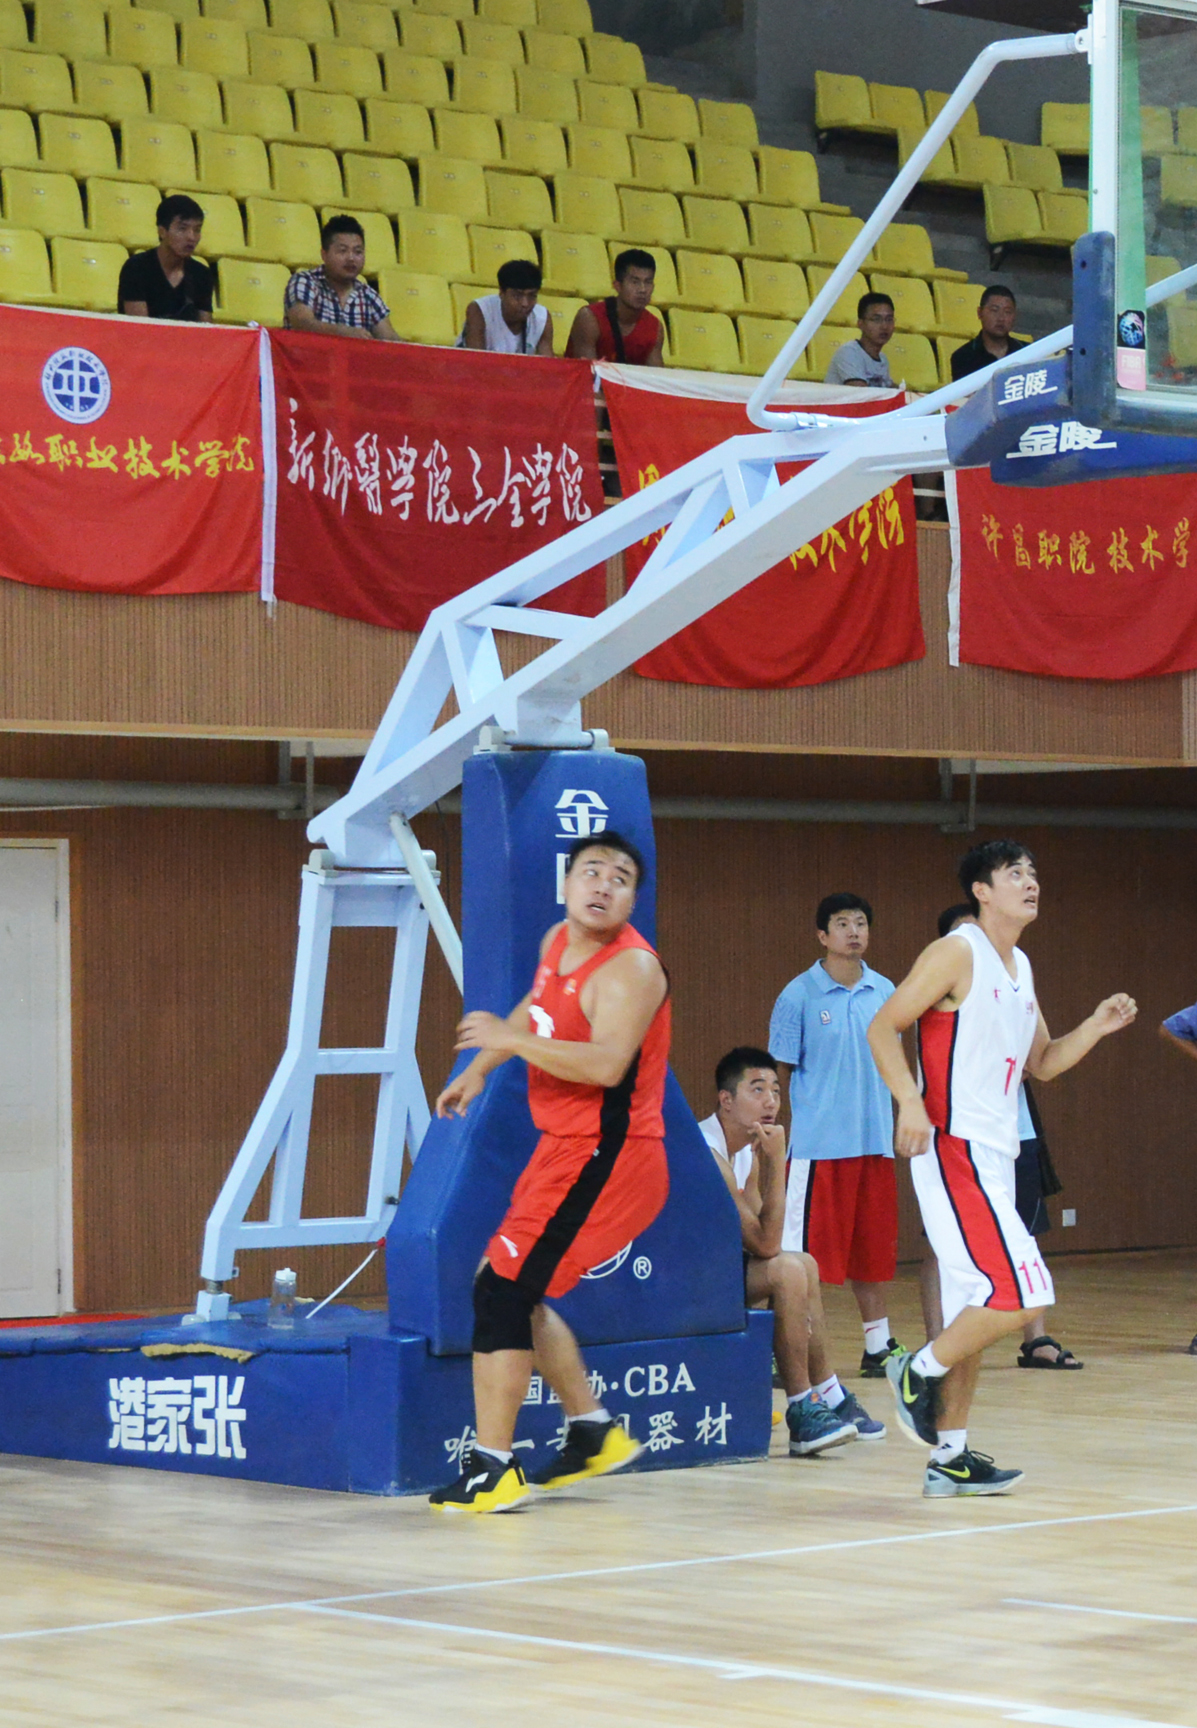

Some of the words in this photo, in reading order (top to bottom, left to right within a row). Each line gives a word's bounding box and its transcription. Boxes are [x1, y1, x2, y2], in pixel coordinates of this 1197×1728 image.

[998, 369, 1058, 405] 金陵
[0, 430, 255, 480] 路职业技术学院
[1006, 420, 1118, 459] 金陵
[1018, 1258, 1047, 1294] 11
